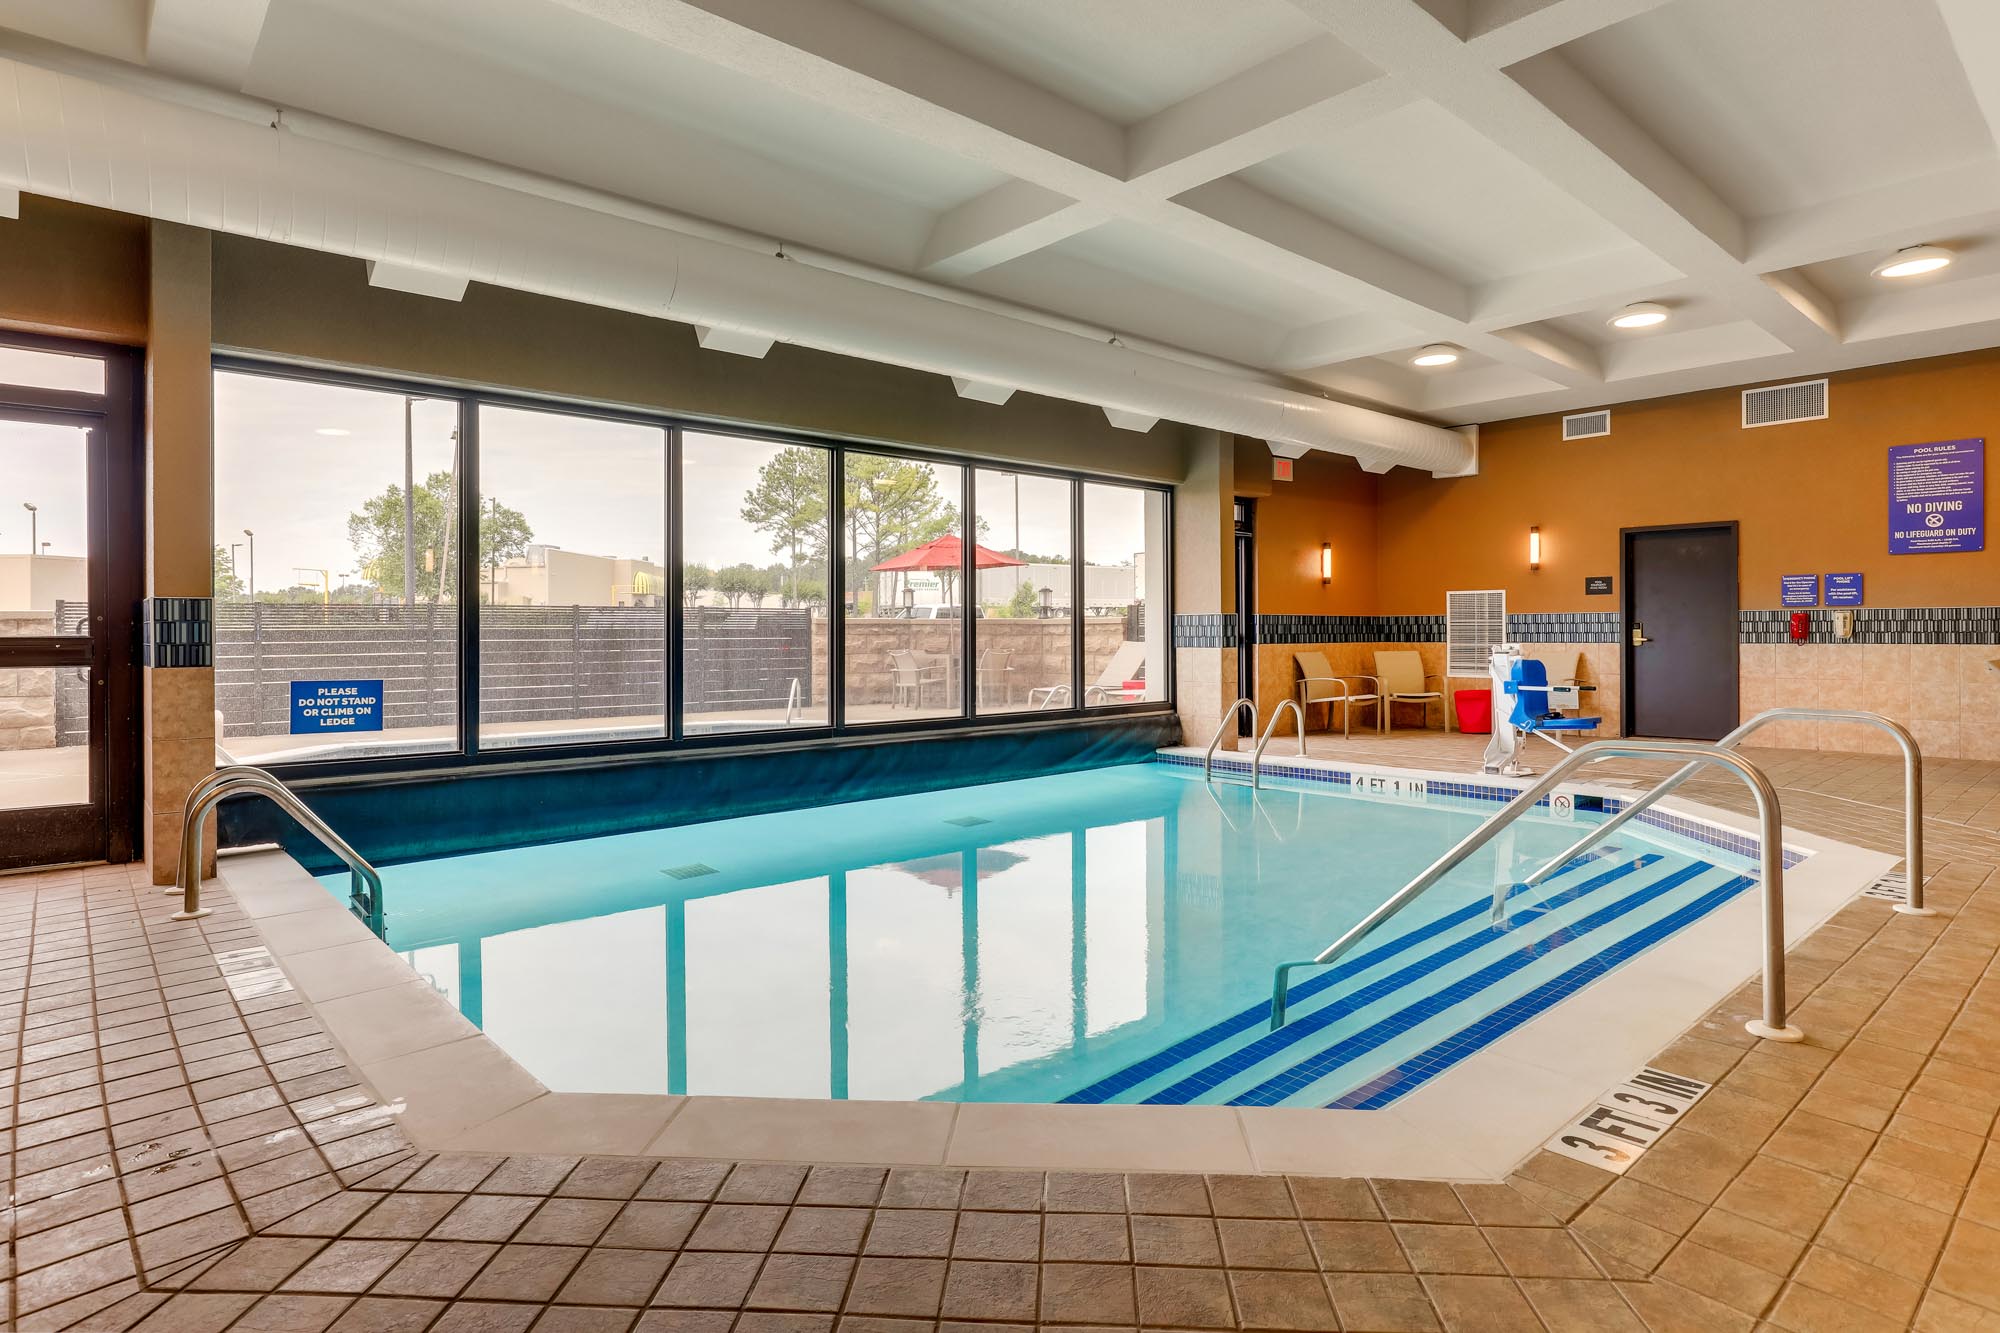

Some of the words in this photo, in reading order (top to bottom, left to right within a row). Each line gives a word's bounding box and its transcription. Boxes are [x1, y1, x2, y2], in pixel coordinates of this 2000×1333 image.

[1906, 503, 1922, 514] NO
[1925, 500, 1963, 513] DIVING
[1894, 531, 1905, 539] NO
[1905, 529, 1944, 538] LIFEGUARD
[1945, 528, 1956, 536] ON
[1958, 527, 1977, 536] DUTY
[317, 687, 358, 696] PLEASE
[298, 699, 315, 707] DO
[317, 698, 340, 706] NOT
[341, 697, 376, 705] STAND
[303, 708, 319, 717] OR
[320, 708, 354, 716] CLIMB
[355, 707, 372, 715] ON
[320, 717, 355, 726] LEDGE
[1370, 778, 1386, 788] FT
[1409, 782, 1423, 792] IN
[1630, 1069, 1705, 1100] IN
[1613, 1092, 1679, 1115] 3
[1579, 1106, 1661, 1145] FT
[1561, 1135, 1631, 1163] 3
